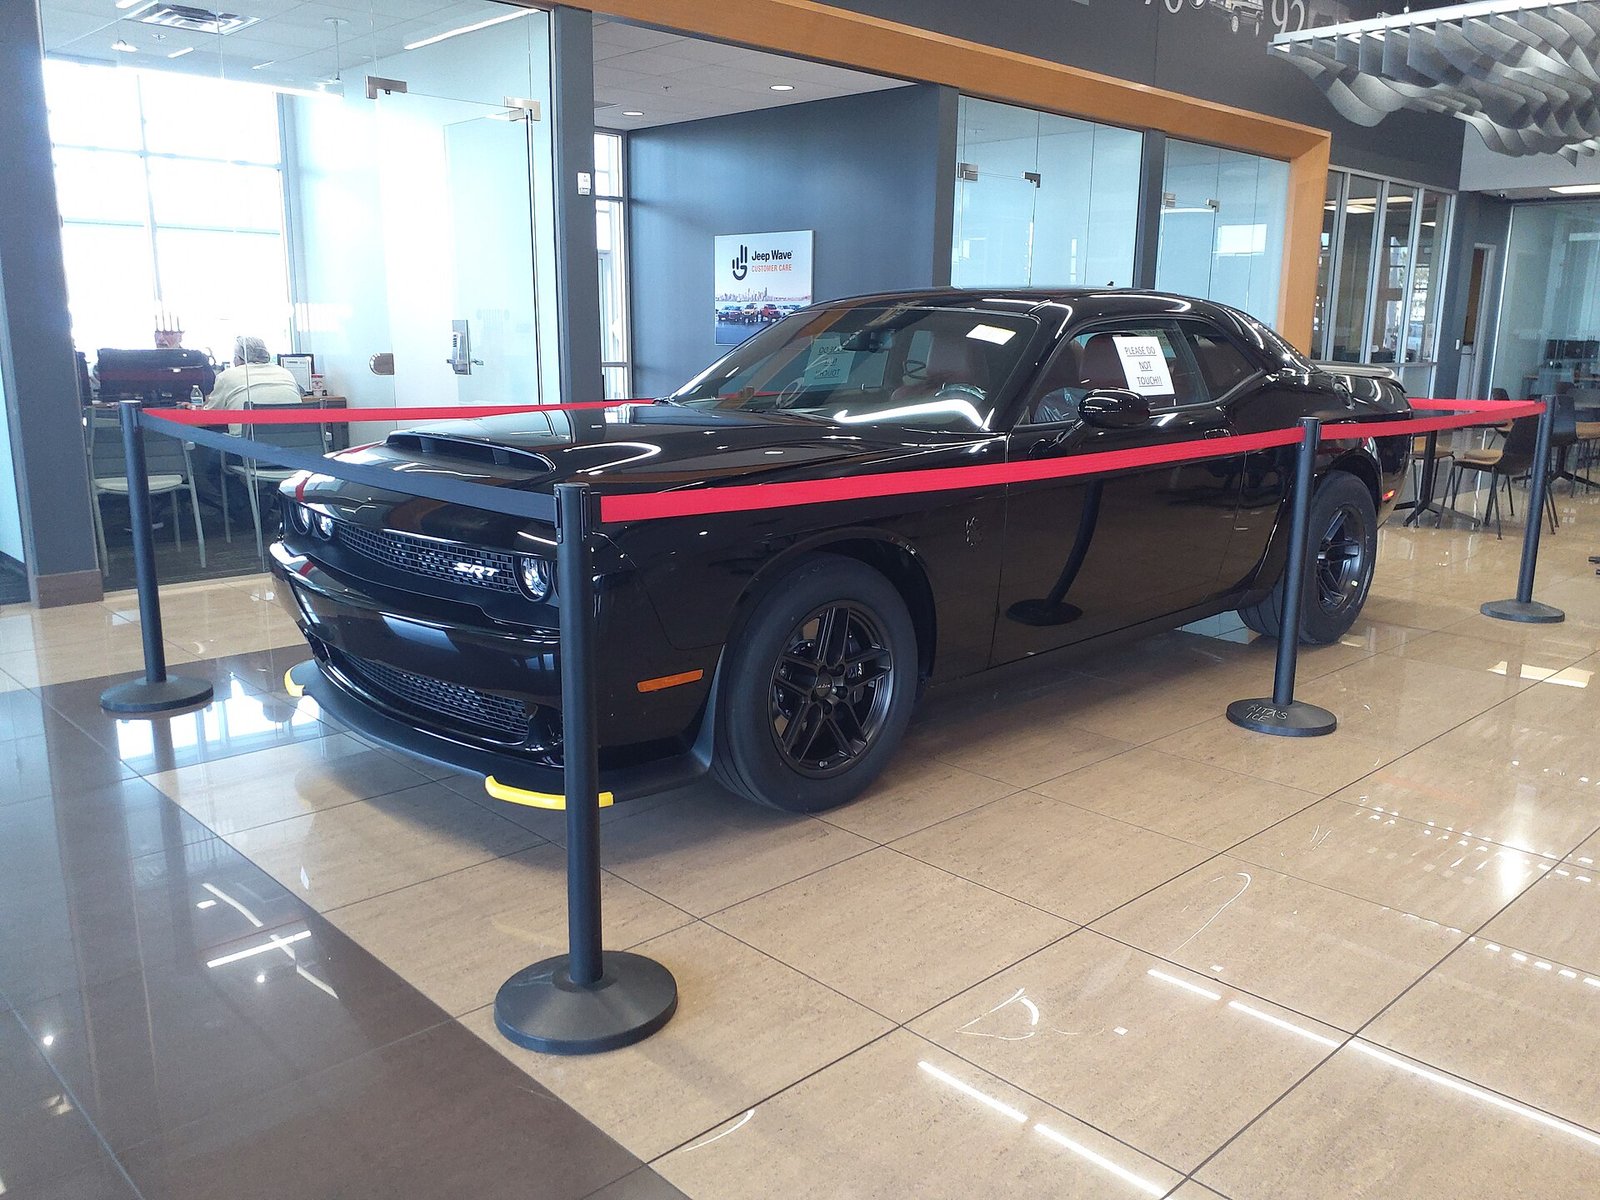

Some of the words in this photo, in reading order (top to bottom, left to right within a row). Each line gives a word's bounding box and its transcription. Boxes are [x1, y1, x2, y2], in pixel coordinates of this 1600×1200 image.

[751, 251, 771, 263] Jeep
[771, 249, 792, 261] Wave
[751, 264, 778, 273] CUSTOMER
[778, 263, 792, 272] CARE
[1124, 346, 1146, 355] PLEASE
[1146, 346, 1156, 354] DO
[1138, 361, 1152, 370] NOT
[453, 562, 501, 579] SRT
[1245, 712, 1270, 722] ICE
